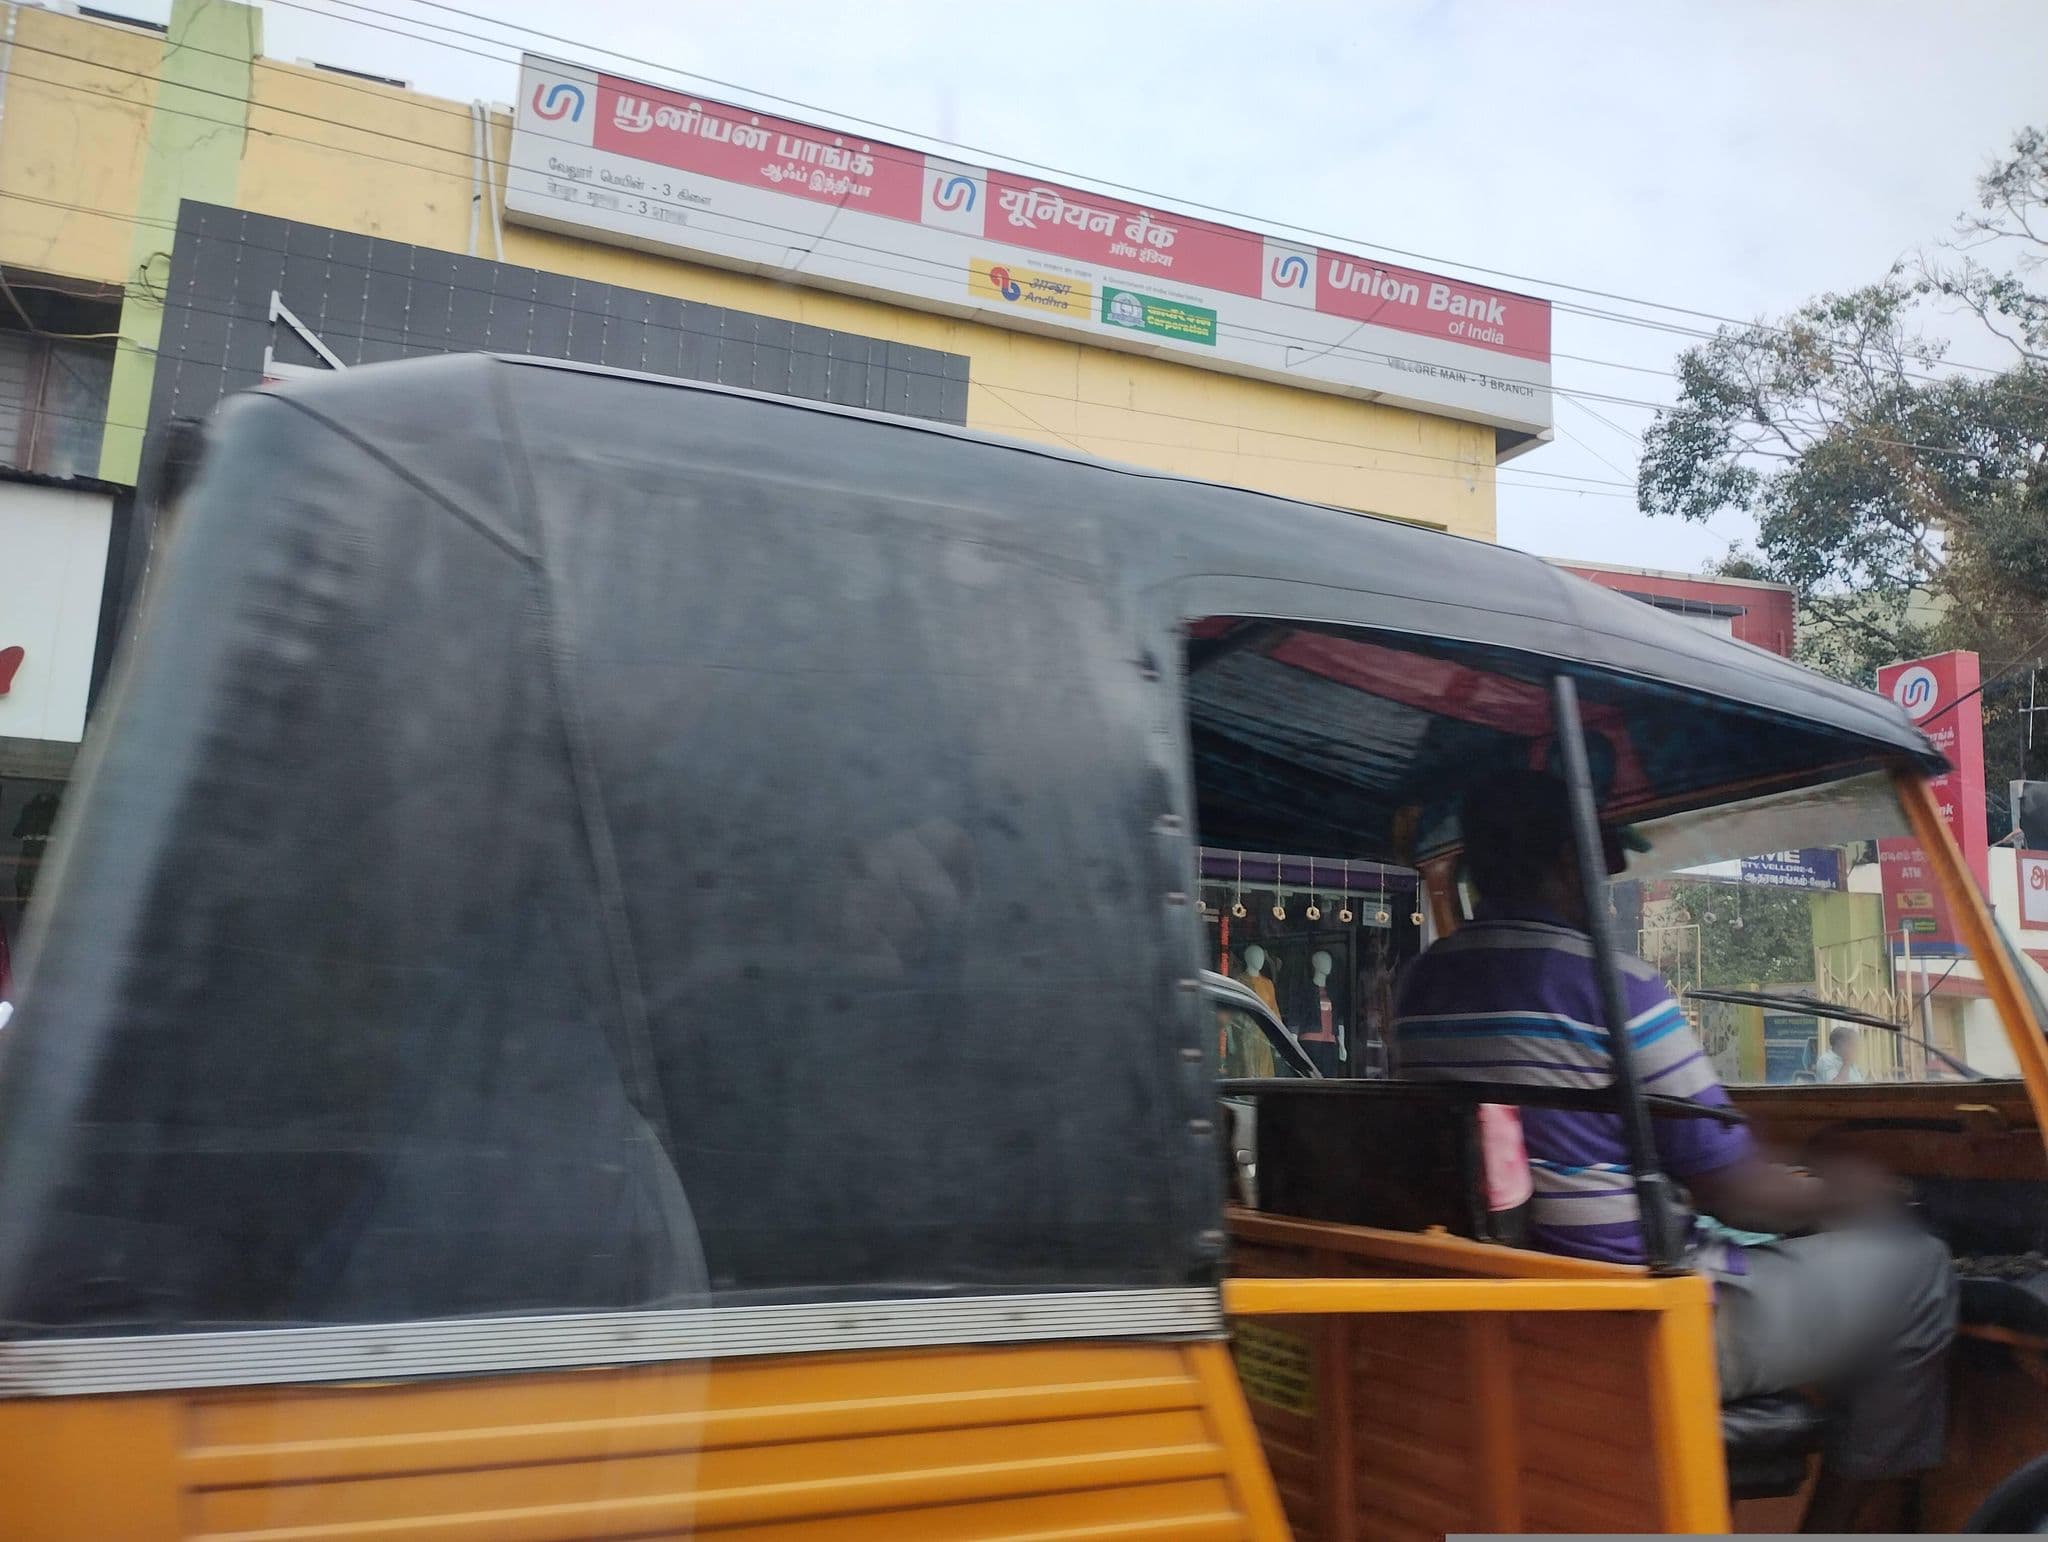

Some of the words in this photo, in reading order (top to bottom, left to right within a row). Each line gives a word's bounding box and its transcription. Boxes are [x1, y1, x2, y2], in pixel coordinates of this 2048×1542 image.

[613, 95, 772, 152] யூனியன்
[777, 138, 874, 177] பாங்க்
[662, 184, 671, 196] 3
[809, 170, 872, 198] இந்தியா
[638, 201, 648, 214] 3
[999, 187, 1119, 236] यूनियन
[1024, 292, 1068, 309] Andhra
[1327, 259, 1420, 306] Union
[1426, 283, 1508, 326] Bank
[1448, 320, 1465, 336] of
[1468, 323, 1504, 345] India
[1440, 368, 1466, 383] MAIN
[1479, 374, 1487, 387] 3
[1490, 379, 1534, 398] BRANCH
